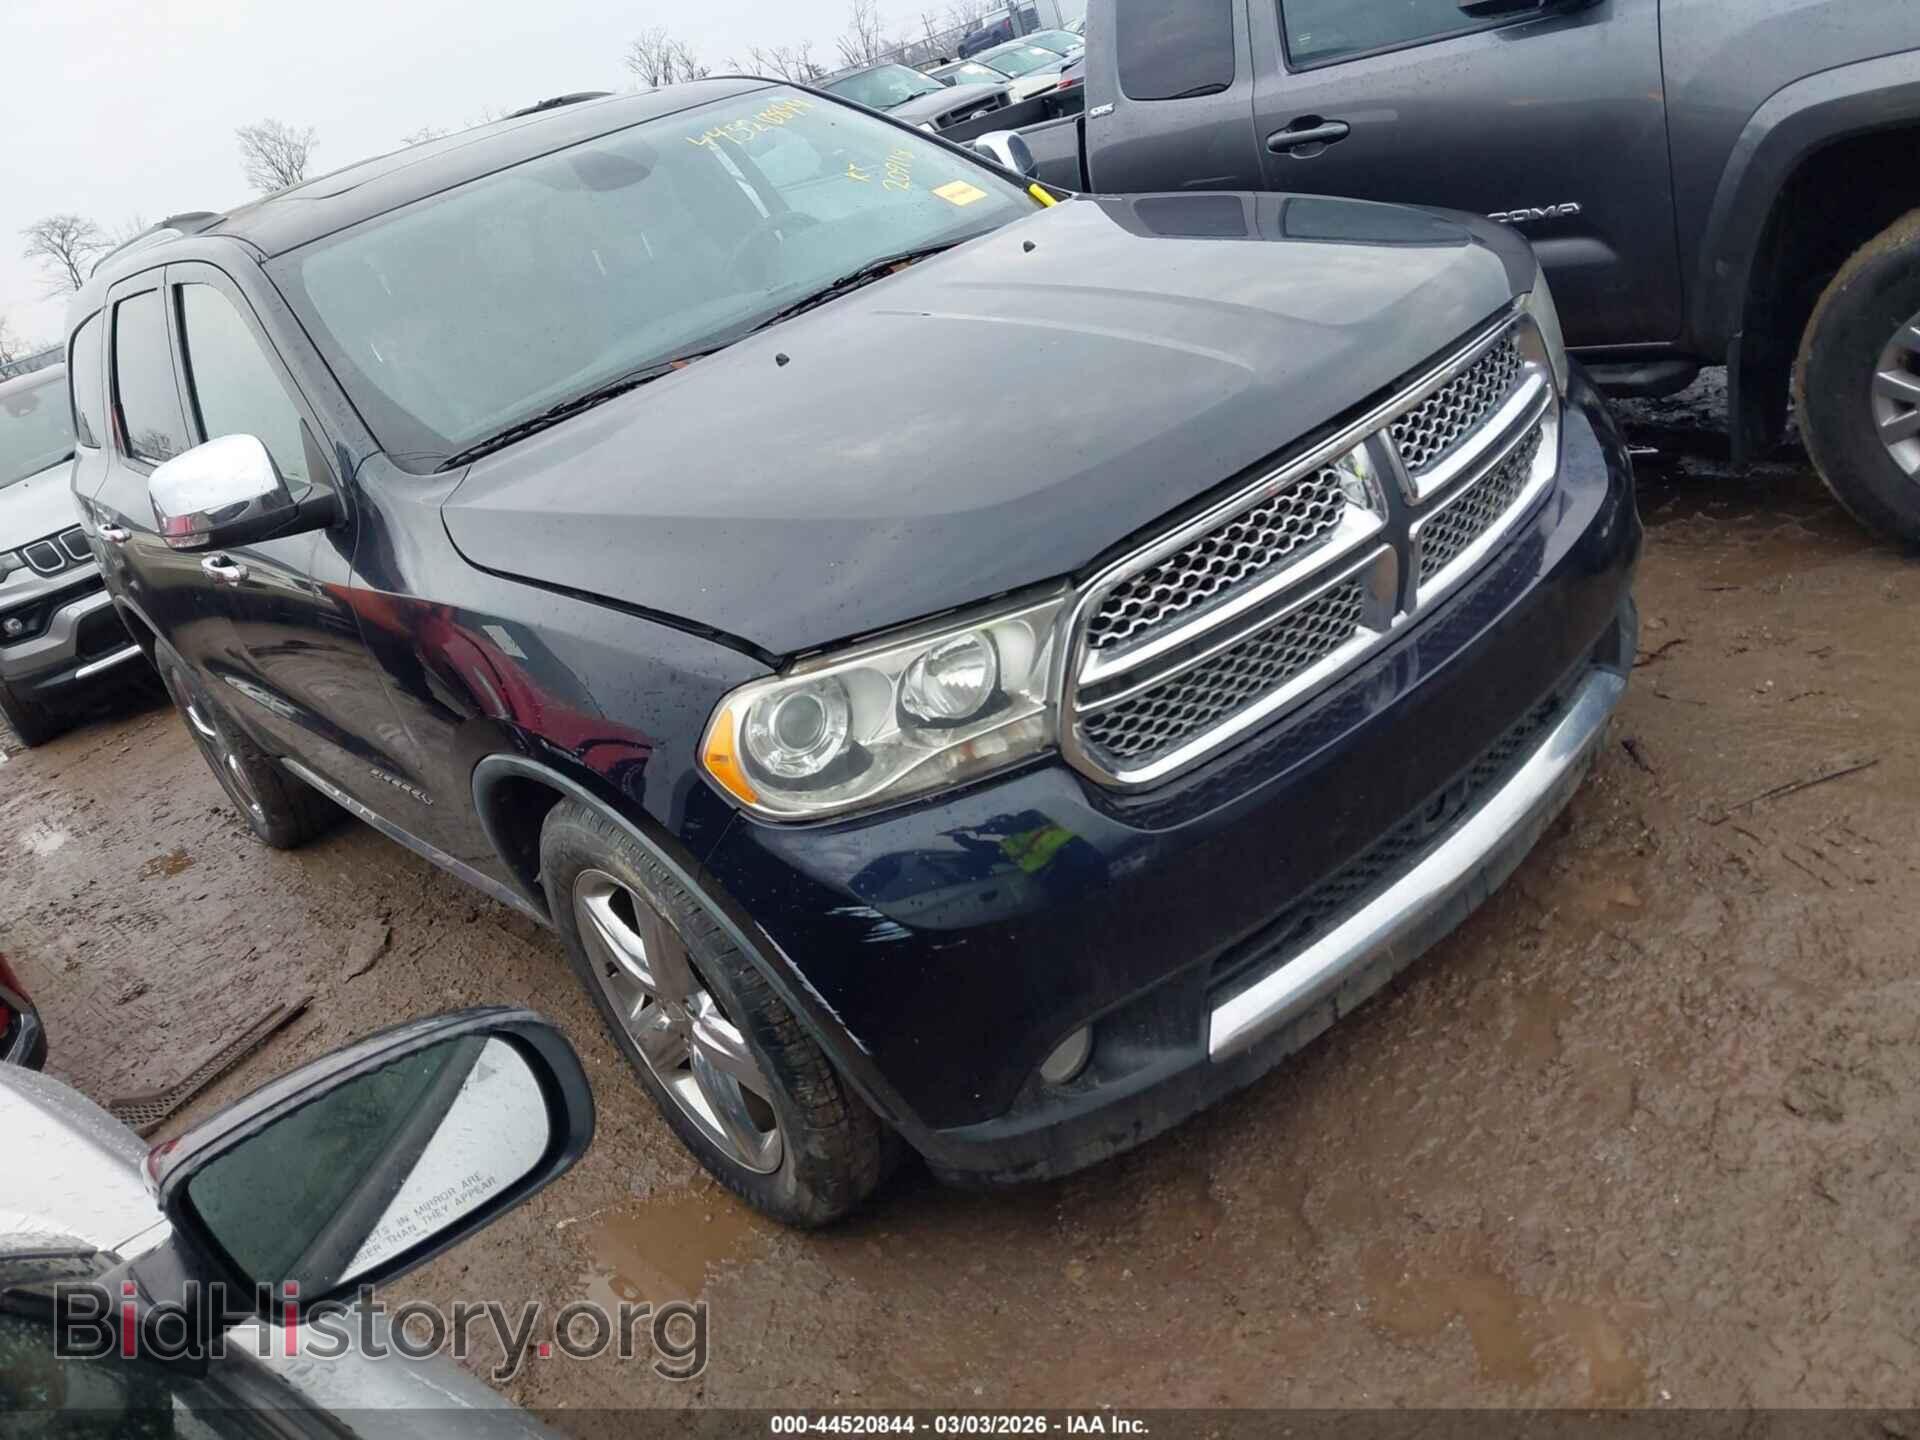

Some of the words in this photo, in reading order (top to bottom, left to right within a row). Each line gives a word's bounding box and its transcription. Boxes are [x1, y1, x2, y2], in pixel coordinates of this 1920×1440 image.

[387, 1225, 418, 1245] THAN
[423, 1206, 449, 1224] THEY
[455, 1176, 496, 1206] APPEAR
[414, 1188, 457, 1215] MIRROR
[461, 1172, 484, 1187] ARE
